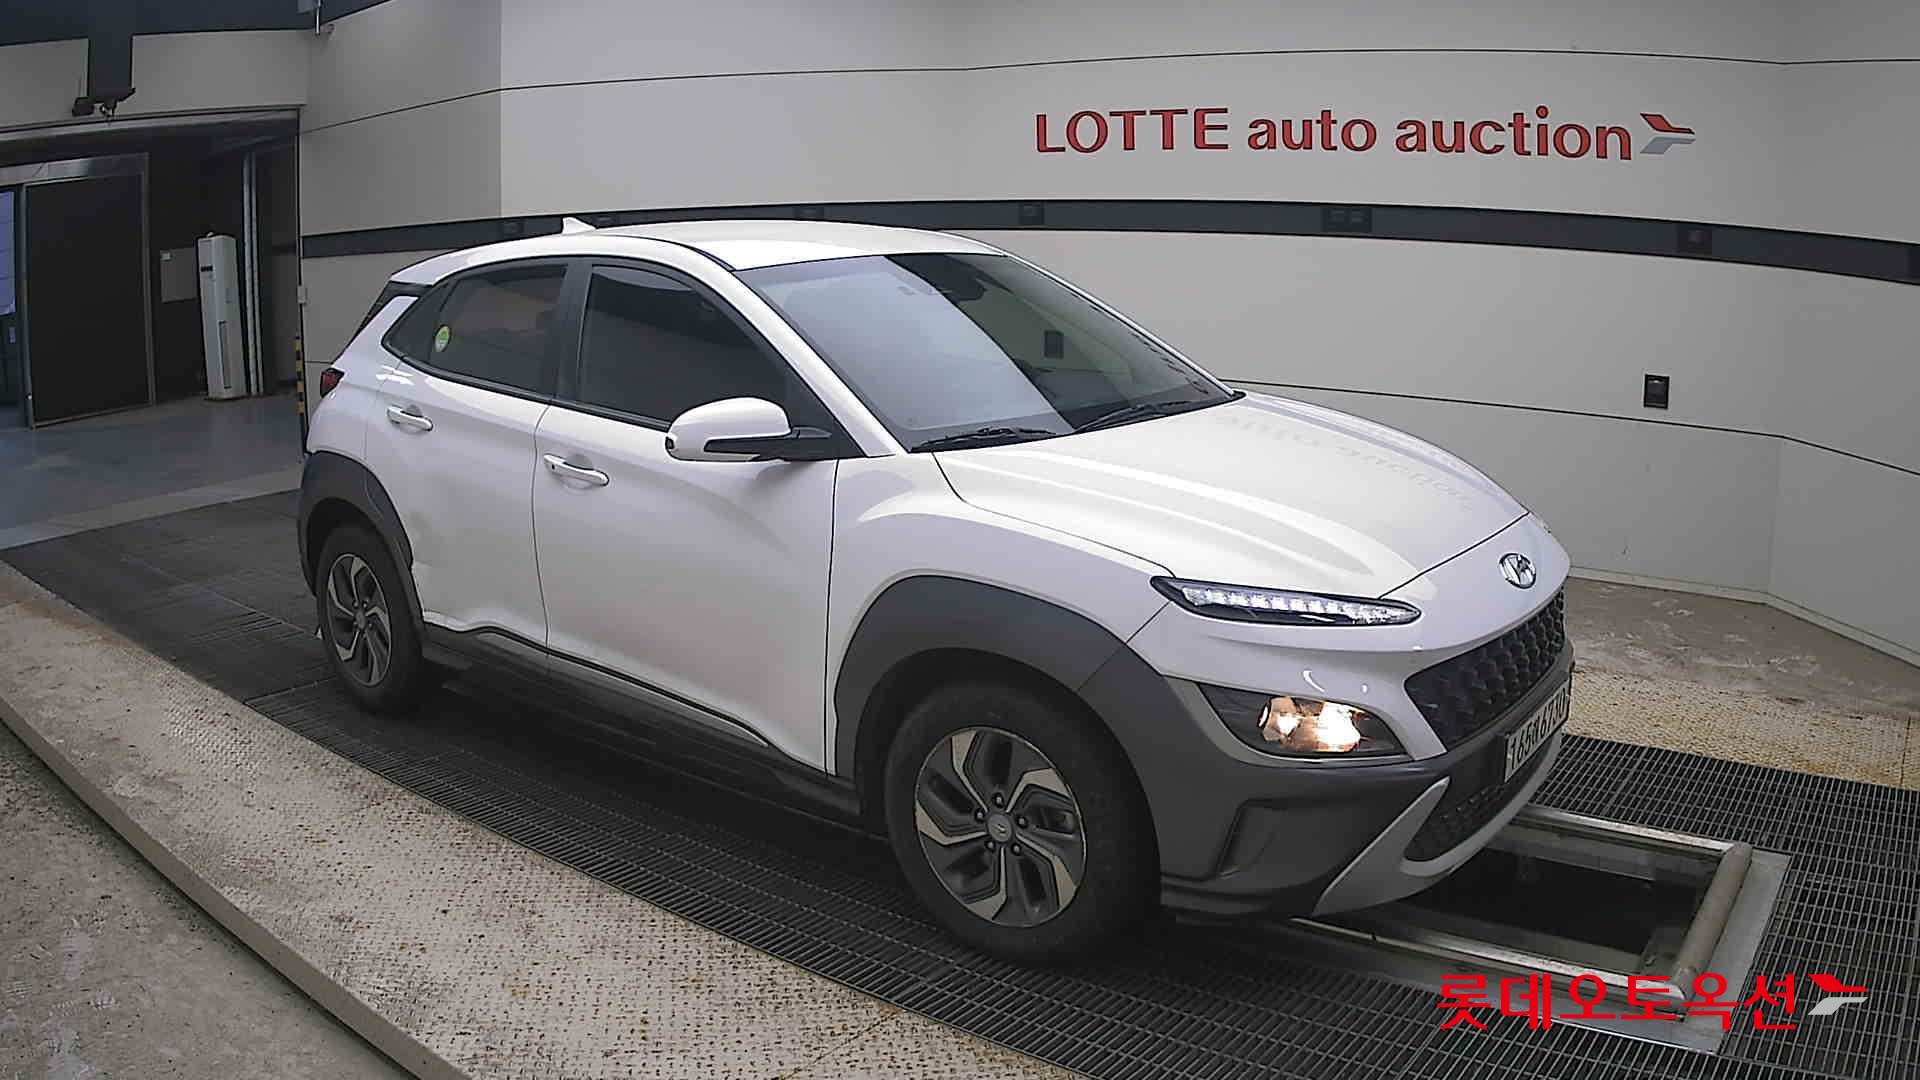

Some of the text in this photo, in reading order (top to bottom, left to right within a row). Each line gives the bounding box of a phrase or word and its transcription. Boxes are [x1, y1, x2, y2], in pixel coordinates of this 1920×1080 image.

[1035, 105, 1633, 161] LOTTE auto auction
